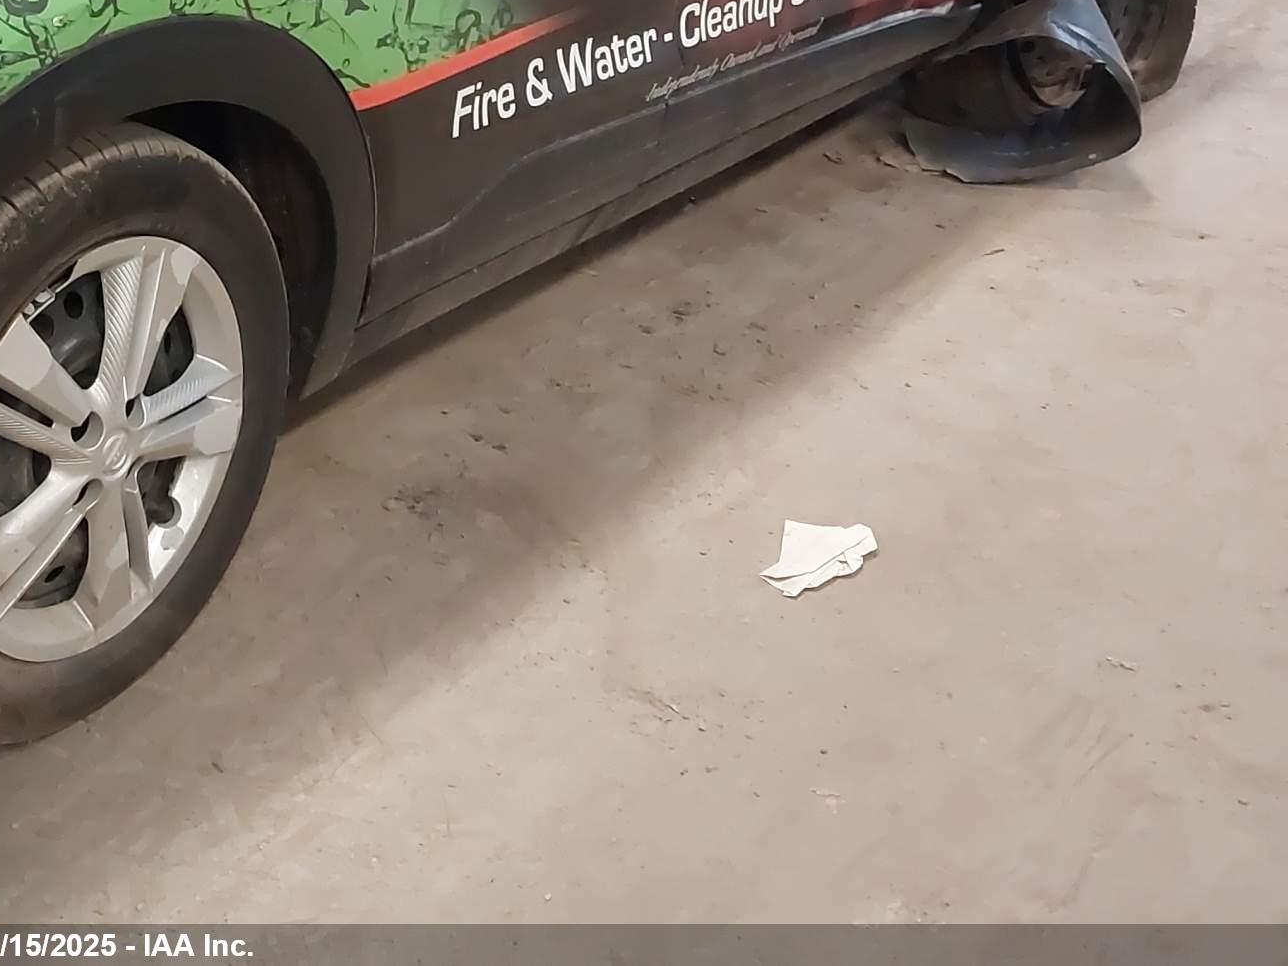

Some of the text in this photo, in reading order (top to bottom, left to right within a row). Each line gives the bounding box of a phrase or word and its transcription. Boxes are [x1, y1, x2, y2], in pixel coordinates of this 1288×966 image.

[452, 82, 517, 139] Fire
[525, 57, 554, 107] &
[556, 28, 658, 95] Water
[663, 31, 674, 43] -
